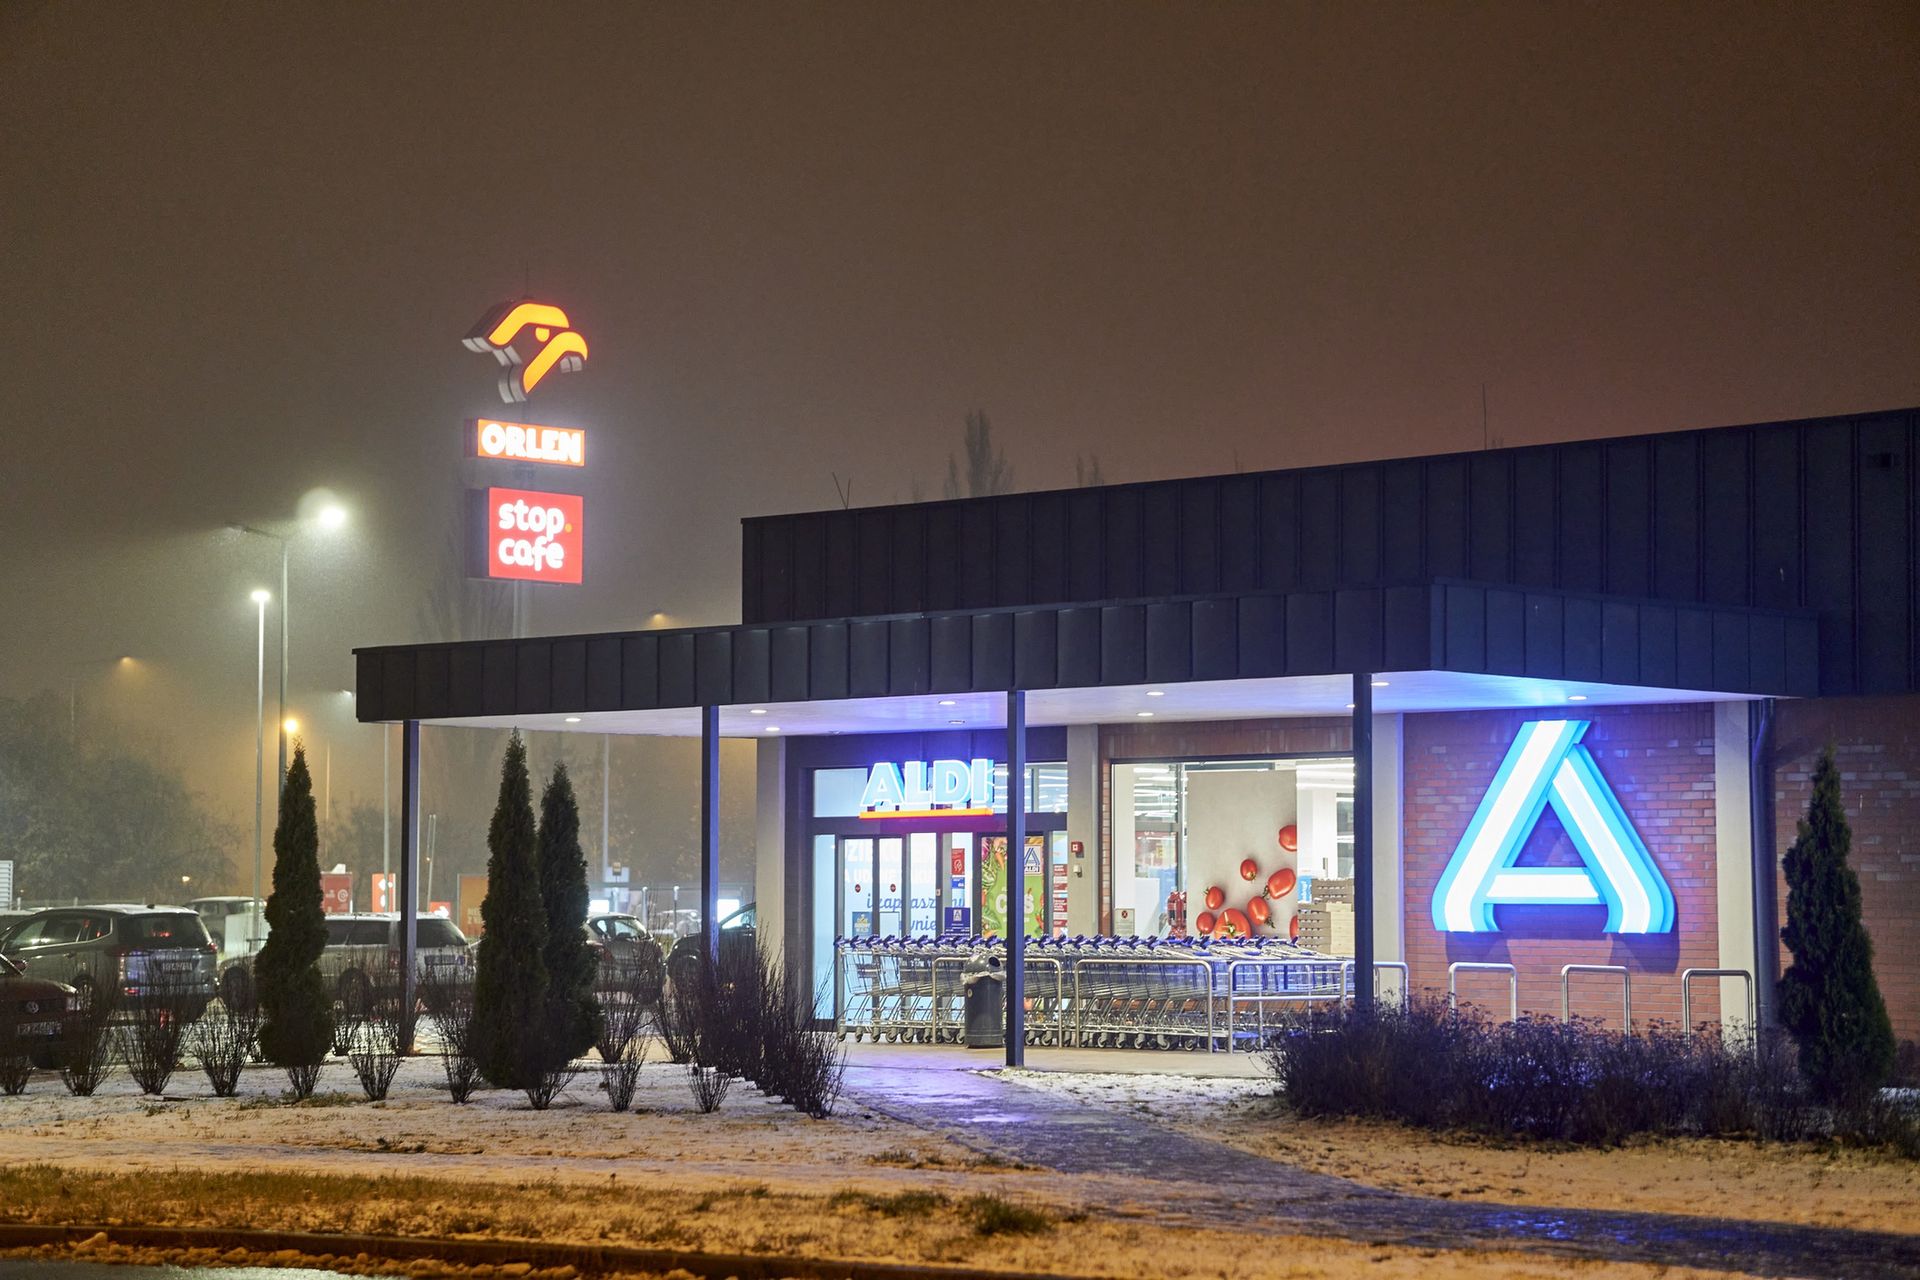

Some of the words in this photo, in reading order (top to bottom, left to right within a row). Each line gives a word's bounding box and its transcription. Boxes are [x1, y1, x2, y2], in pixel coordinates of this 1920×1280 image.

[481, 423, 582, 463] ORLEN
[498, 535, 565, 572] cafe
[860, 758, 994, 808] ALDI
